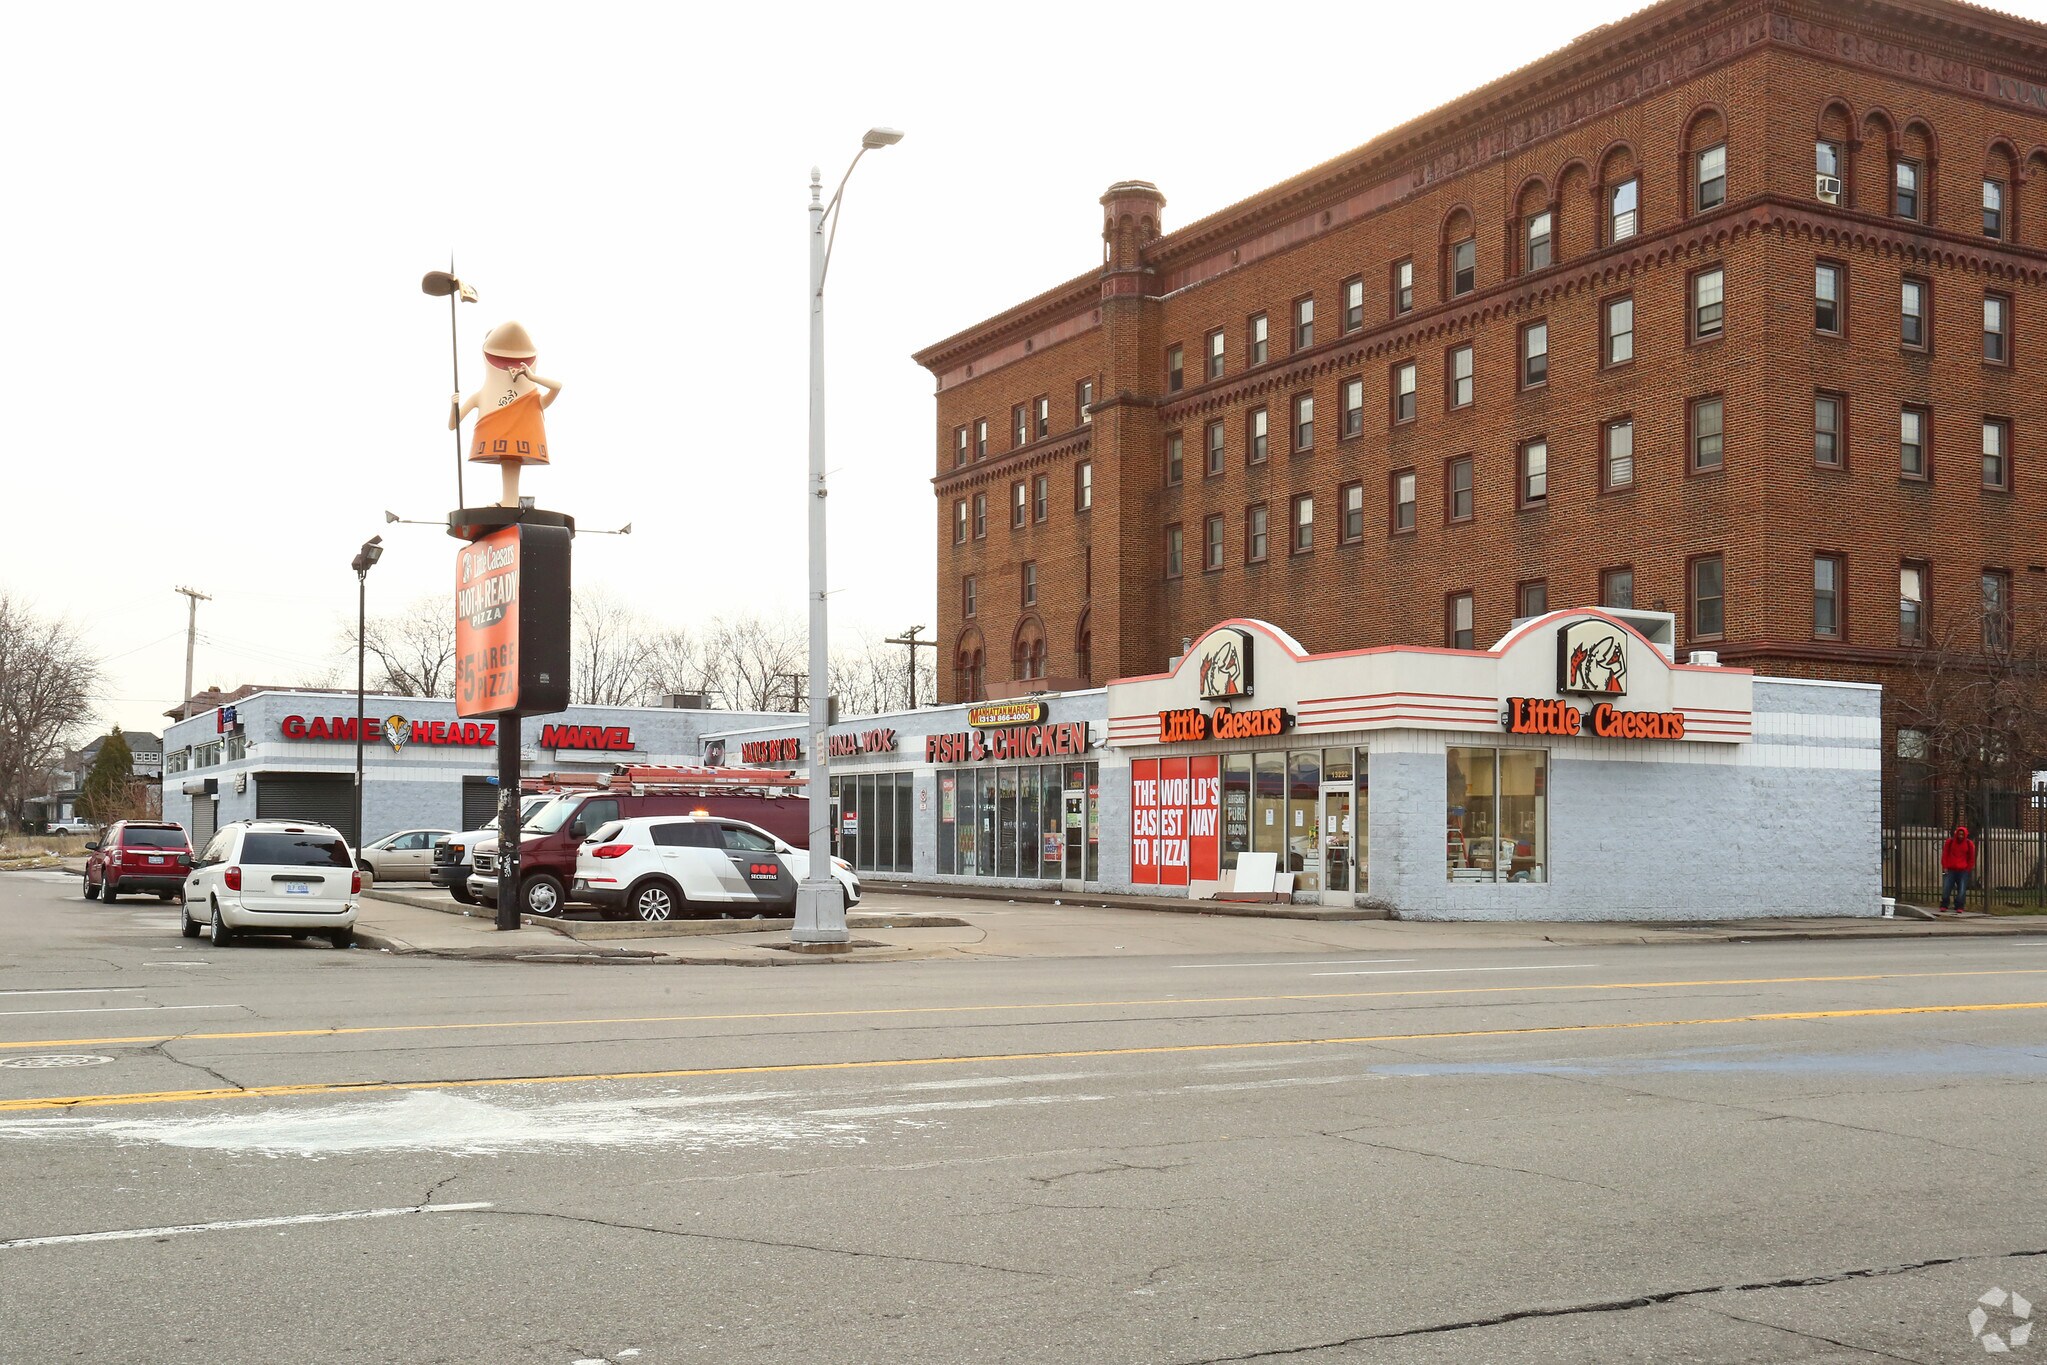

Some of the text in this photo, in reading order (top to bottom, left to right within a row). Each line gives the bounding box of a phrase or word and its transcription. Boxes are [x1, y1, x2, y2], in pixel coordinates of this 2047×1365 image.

[1994, 75, 2047, 109] YOUN
[487, 545, 514, 571] Caesars
[458, 570, 518, 618] HOT-N-READY
[472, 607, 502, 627] PIZZA
[478, 642, 514, 672] LARGE
[478, 671, 514, 699] PIZZA
[971, 704, 1037, 724] MANHATTAN MARKET
[980, 715, 996, 723] (313)
[1159, 707, 1282, 743] Little Caesars
[1511, 697, 1685, 740] Little Caesars
[281, 715, 497, 746] GAME HEADZ
[541, 724, 636, 750] MARVEL
[860, 728, 893, 752] WOK
[925, 721, 1085, 763] FISH & CHICKEN
[1133, 779, 1156, 806] THE
[1188, 809, 1217, 836] WAY
[1227, 806, 1247, 821] PORK
[1133, 838, 1189, 867] TO PIZZA
